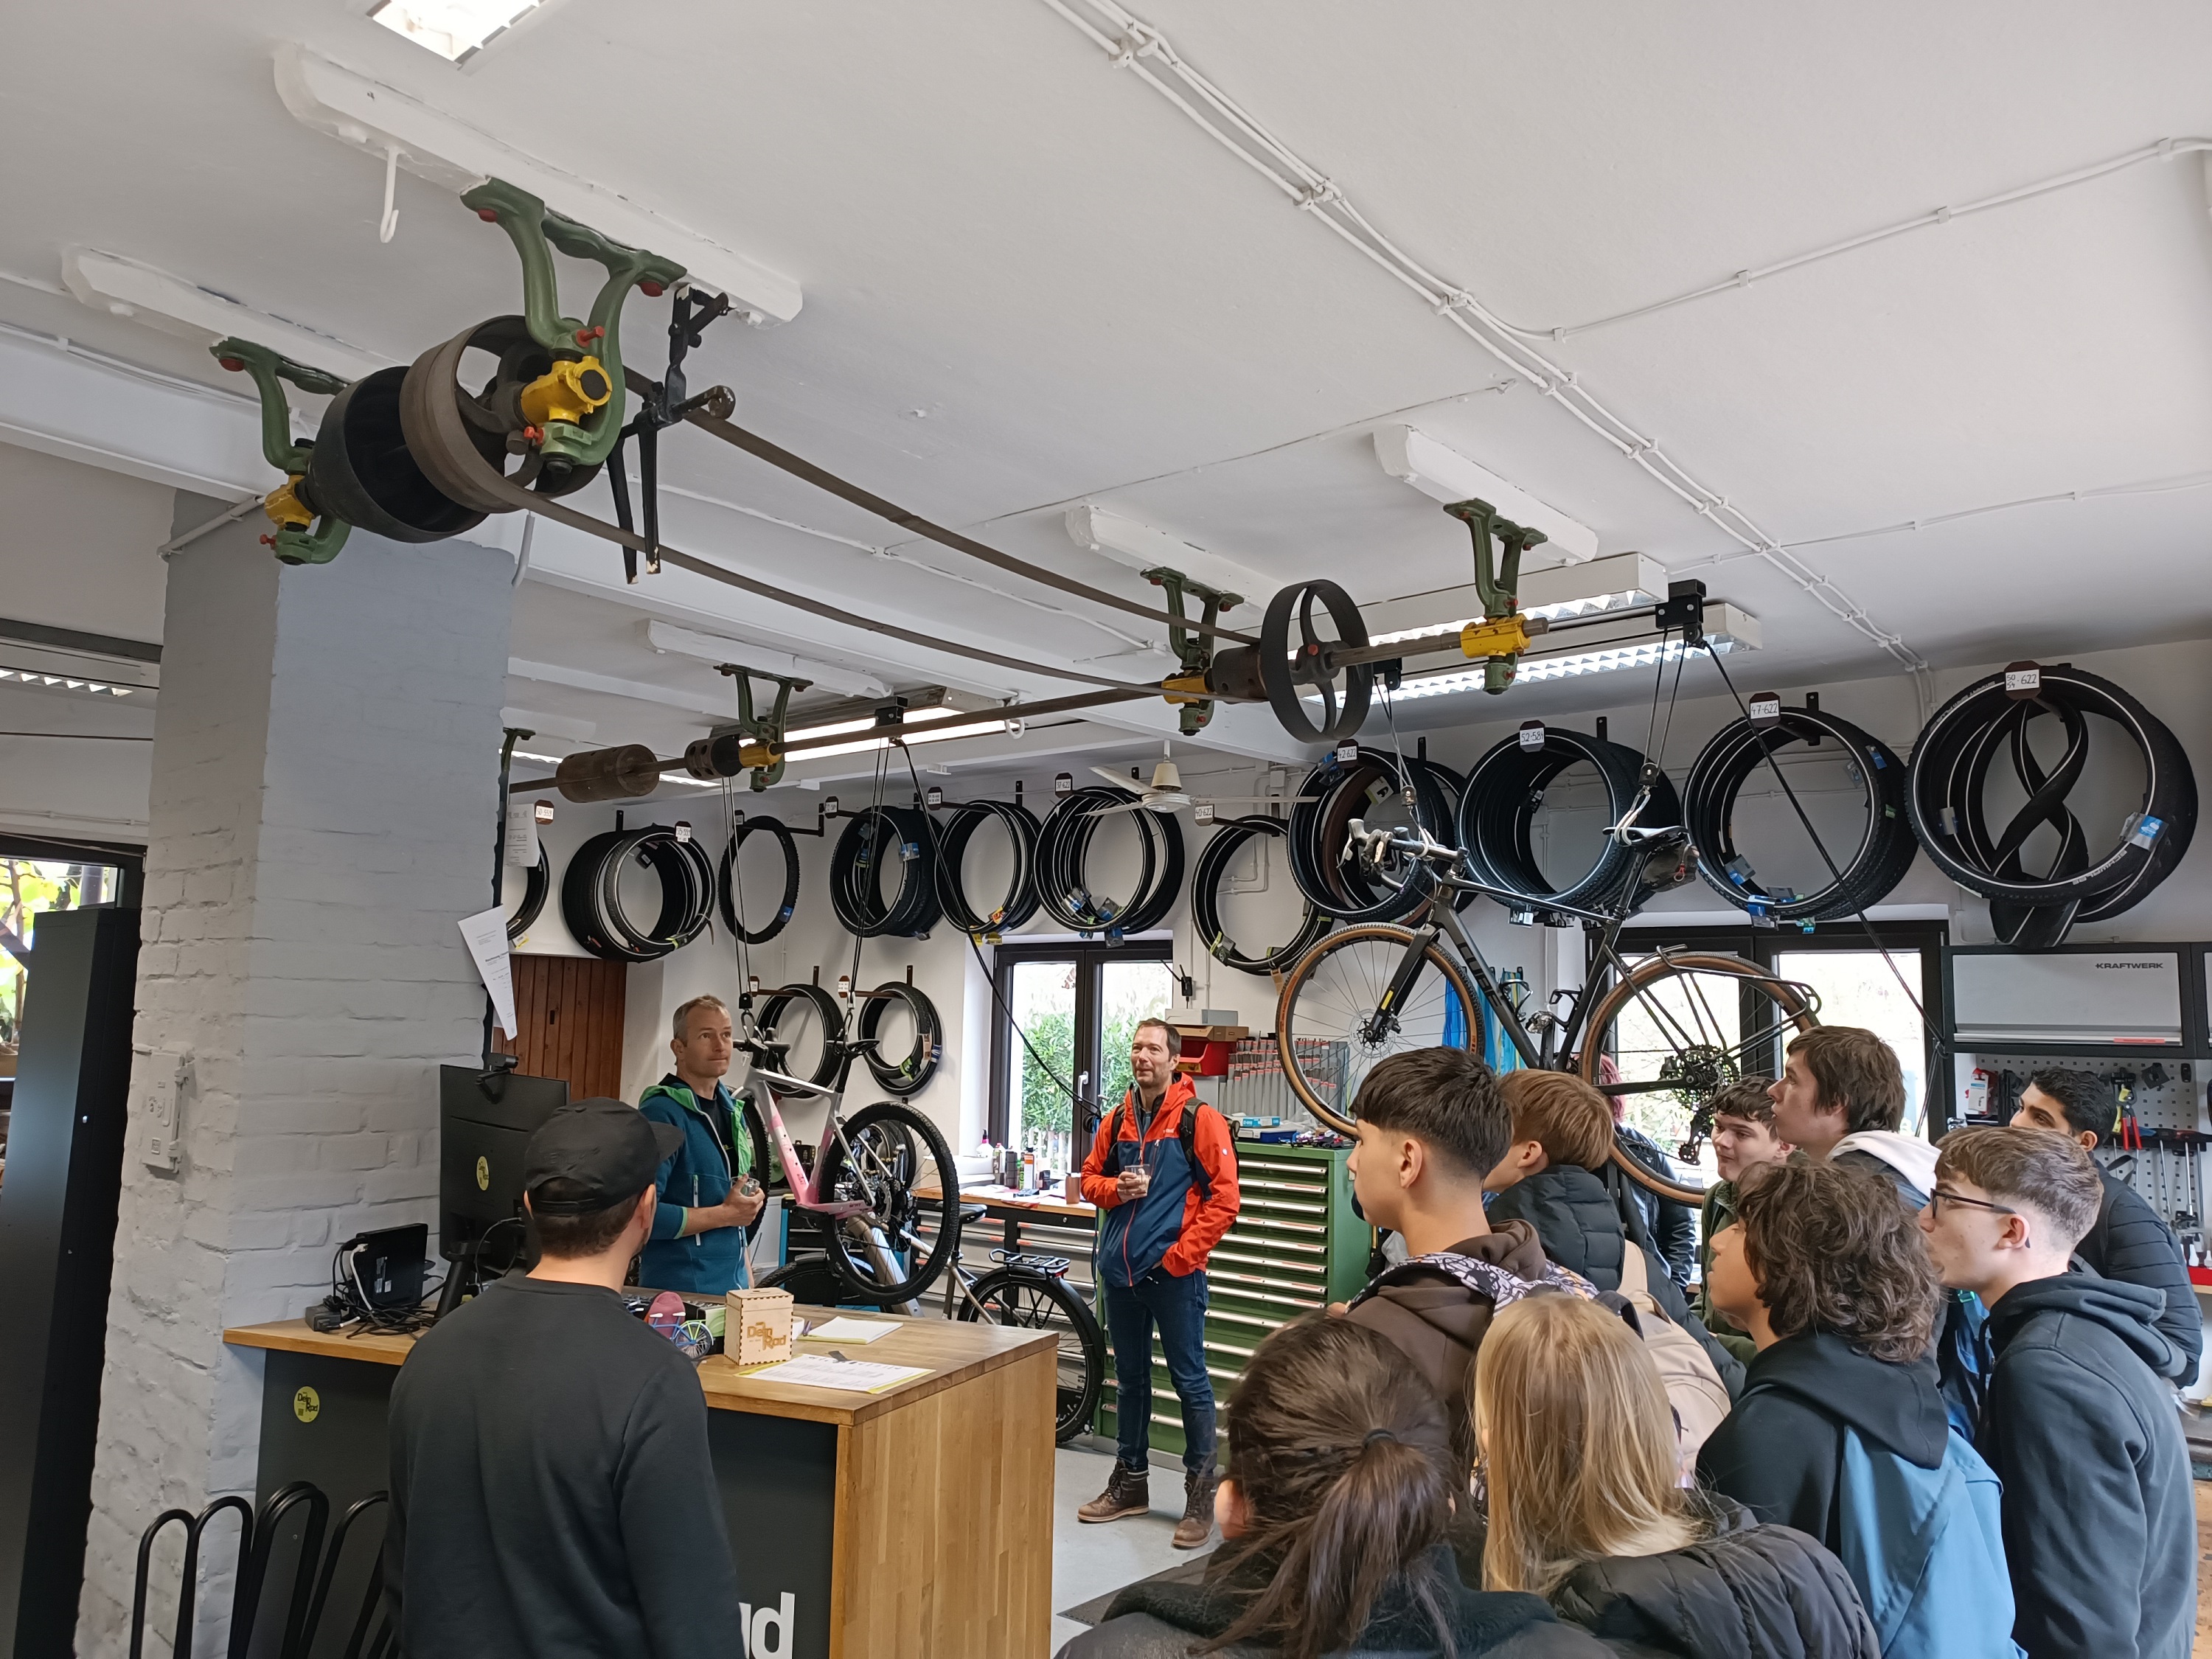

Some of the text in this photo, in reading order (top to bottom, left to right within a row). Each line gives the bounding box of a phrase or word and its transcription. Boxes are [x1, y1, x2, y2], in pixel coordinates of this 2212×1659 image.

[2007, 681, 2015, 689] 54
[1751, 703, 1778, 715] 47-622
[1521, 730, 1544, 743] 52-584
[747, 1321, 773, 1338] Dein
[762, 1335, 787, 1351] Rad
